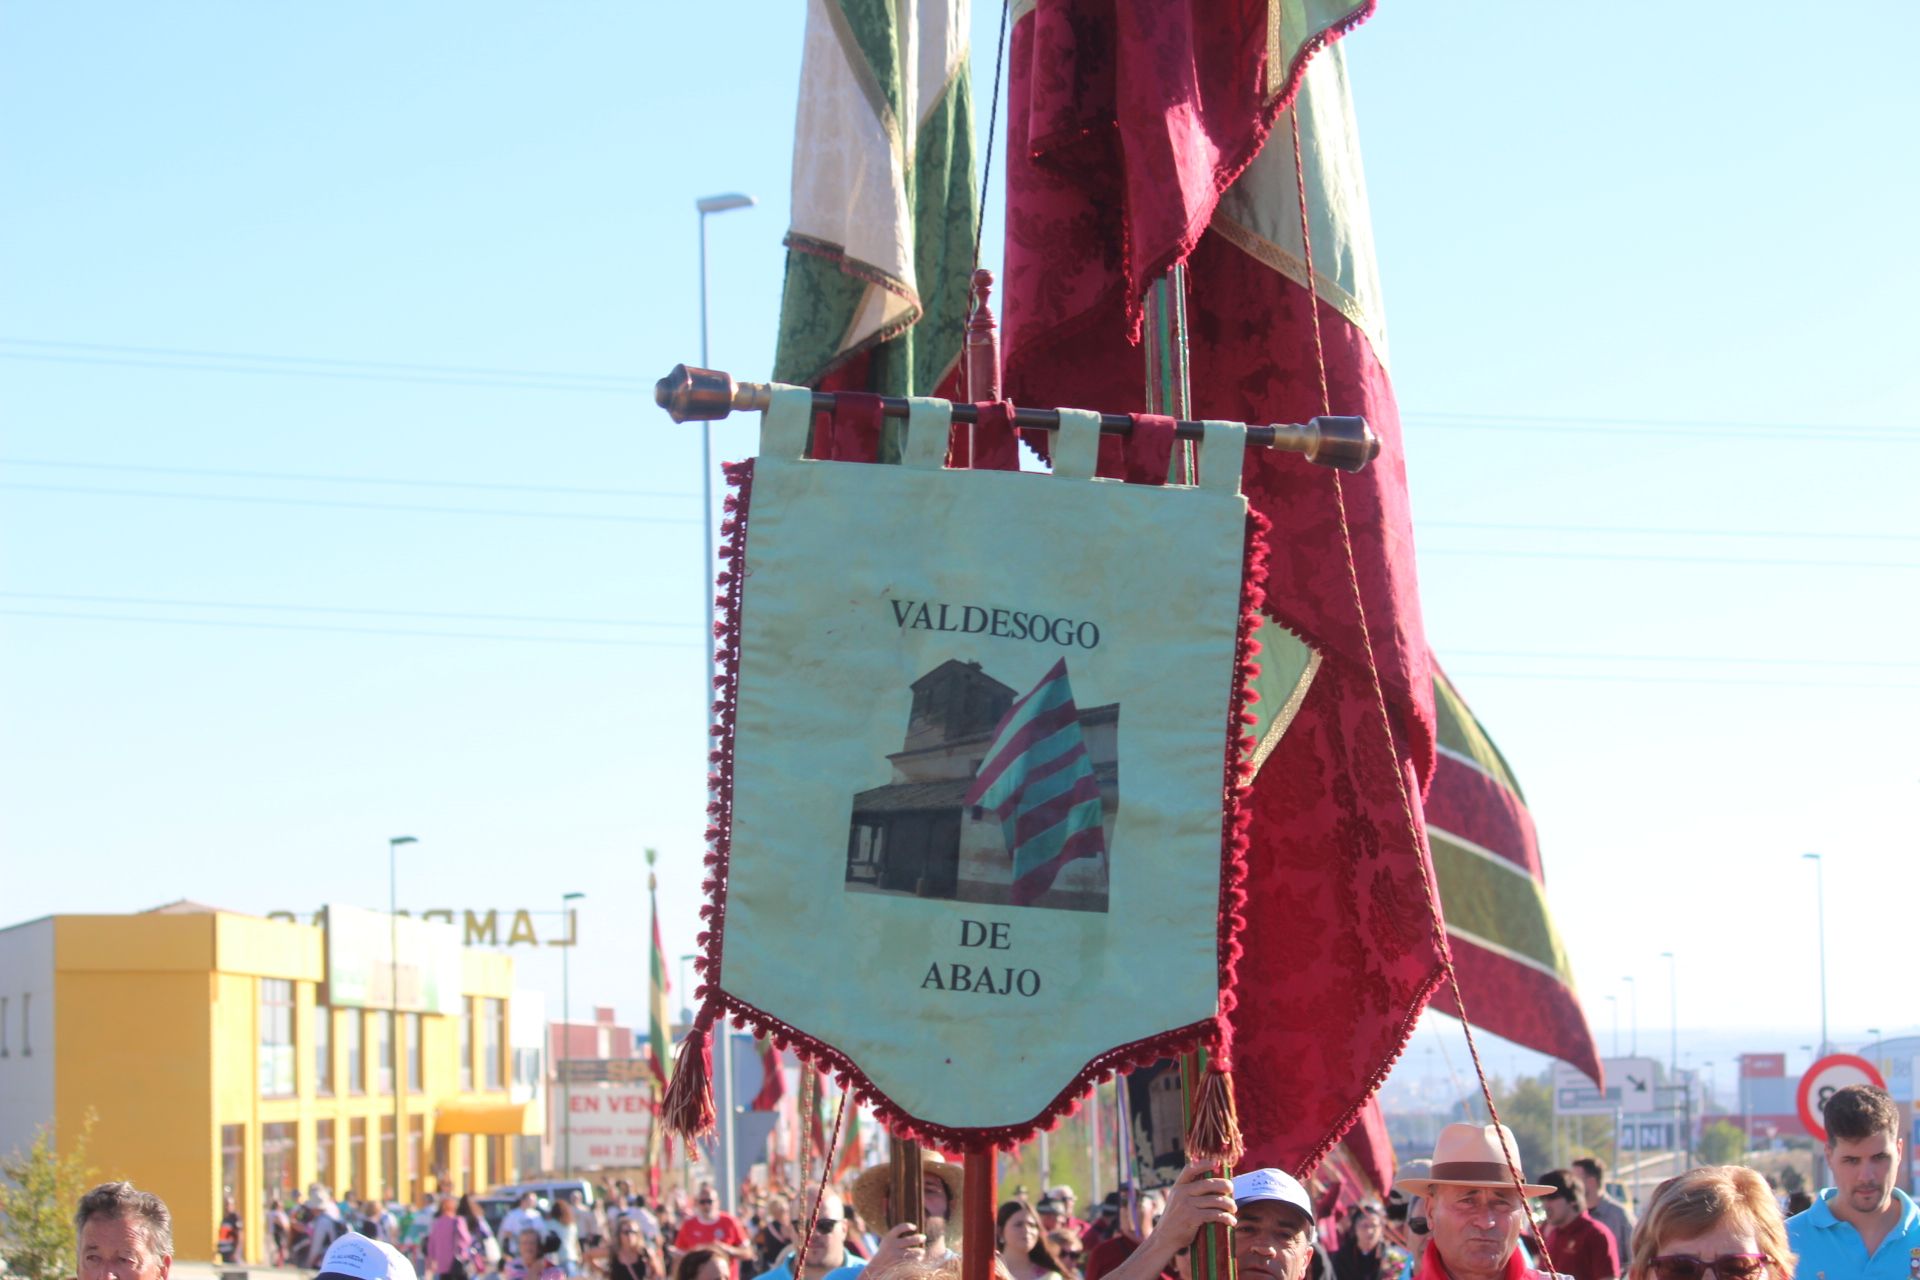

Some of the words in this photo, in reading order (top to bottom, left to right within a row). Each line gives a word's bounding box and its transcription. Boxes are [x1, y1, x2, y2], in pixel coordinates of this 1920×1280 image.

[891, 599, 1100, 649] VALDESOGO
[959, 919, 1012, 950] DE
[920, 961, 1041, 997] ABAJO
[569, 1096, 599, 1113] EN
[607, 1096, 653, 1113] VEN
[1616, 1126, 1667, 1148] MNI
